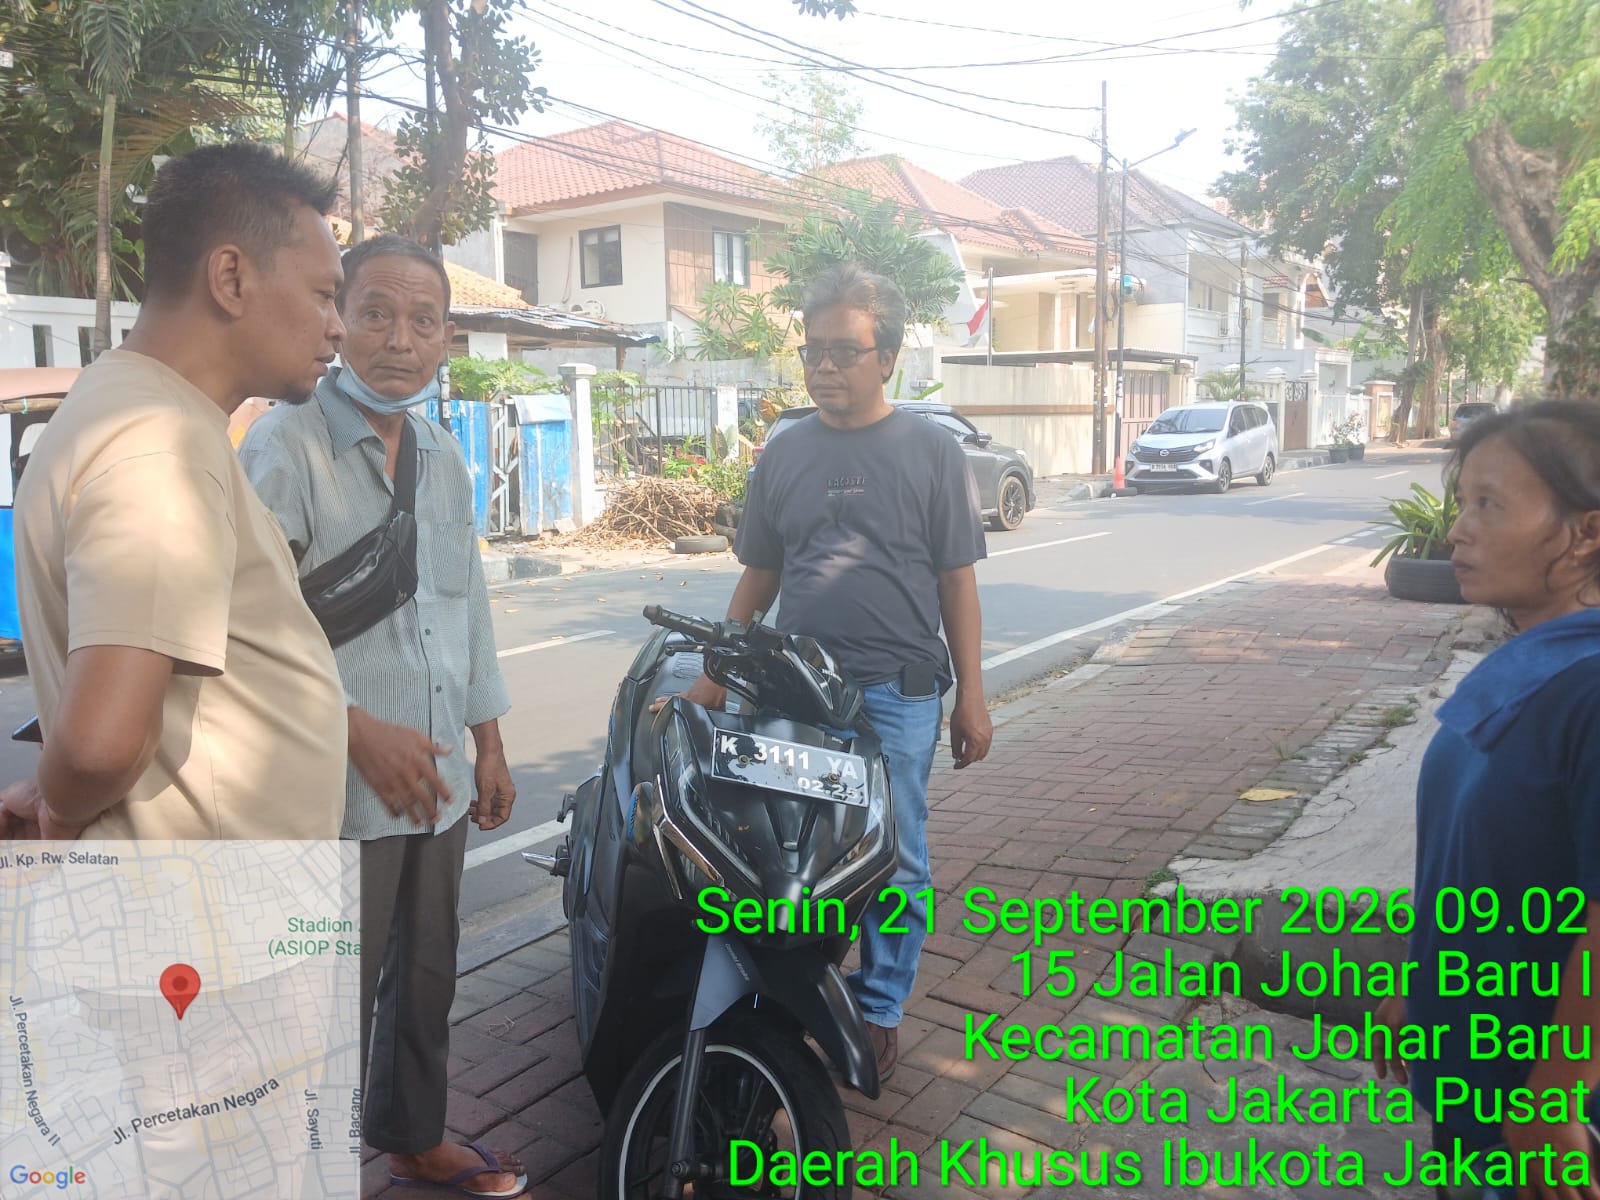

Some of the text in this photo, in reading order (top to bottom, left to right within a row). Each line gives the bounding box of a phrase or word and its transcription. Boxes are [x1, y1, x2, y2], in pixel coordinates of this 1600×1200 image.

[720, 735, 858, 780] K 3111 YA
